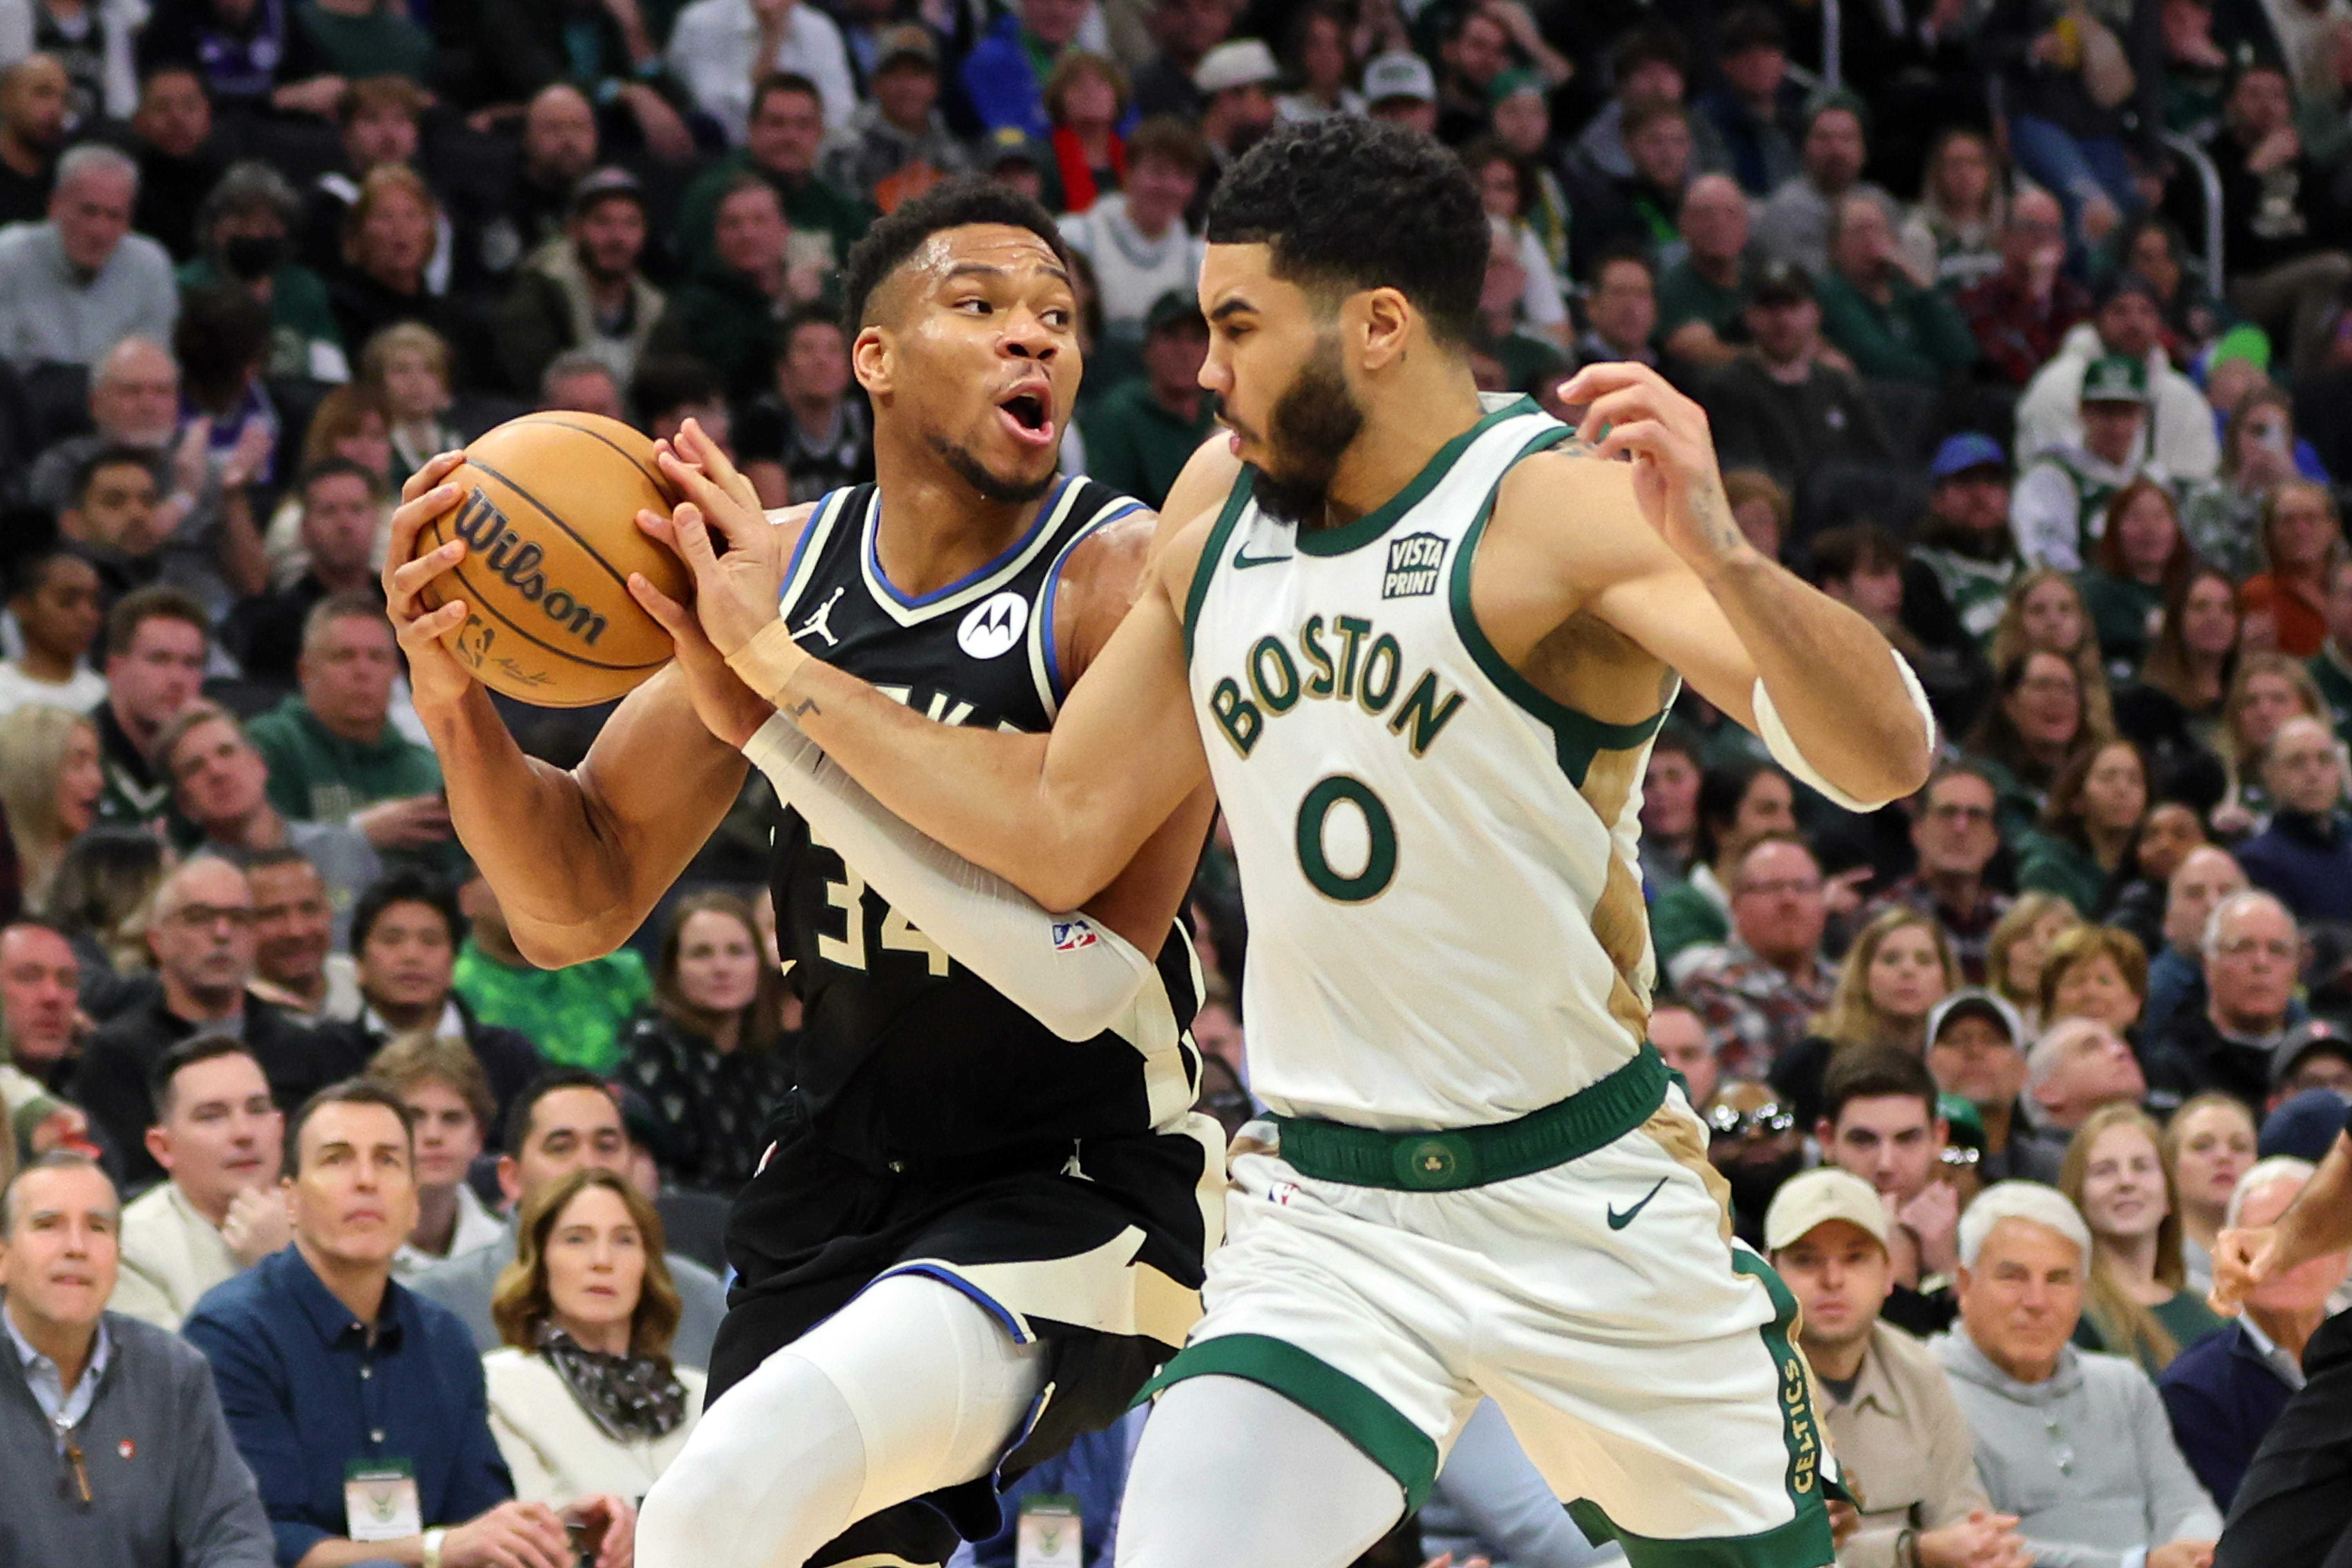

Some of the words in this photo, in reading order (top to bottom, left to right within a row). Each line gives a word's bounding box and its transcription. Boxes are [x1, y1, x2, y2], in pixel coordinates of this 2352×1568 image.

[456, 485, 608, 647] Wilson
[1385, 570, 1438, 596] PRINT
[1392, 537, 1444, 570] VISTA
[1209, 613, 1467, 761] BOSTON
[1295, 772, 1401, 907] 0
[1784, 1358, 1817, 1494] CELTICS
